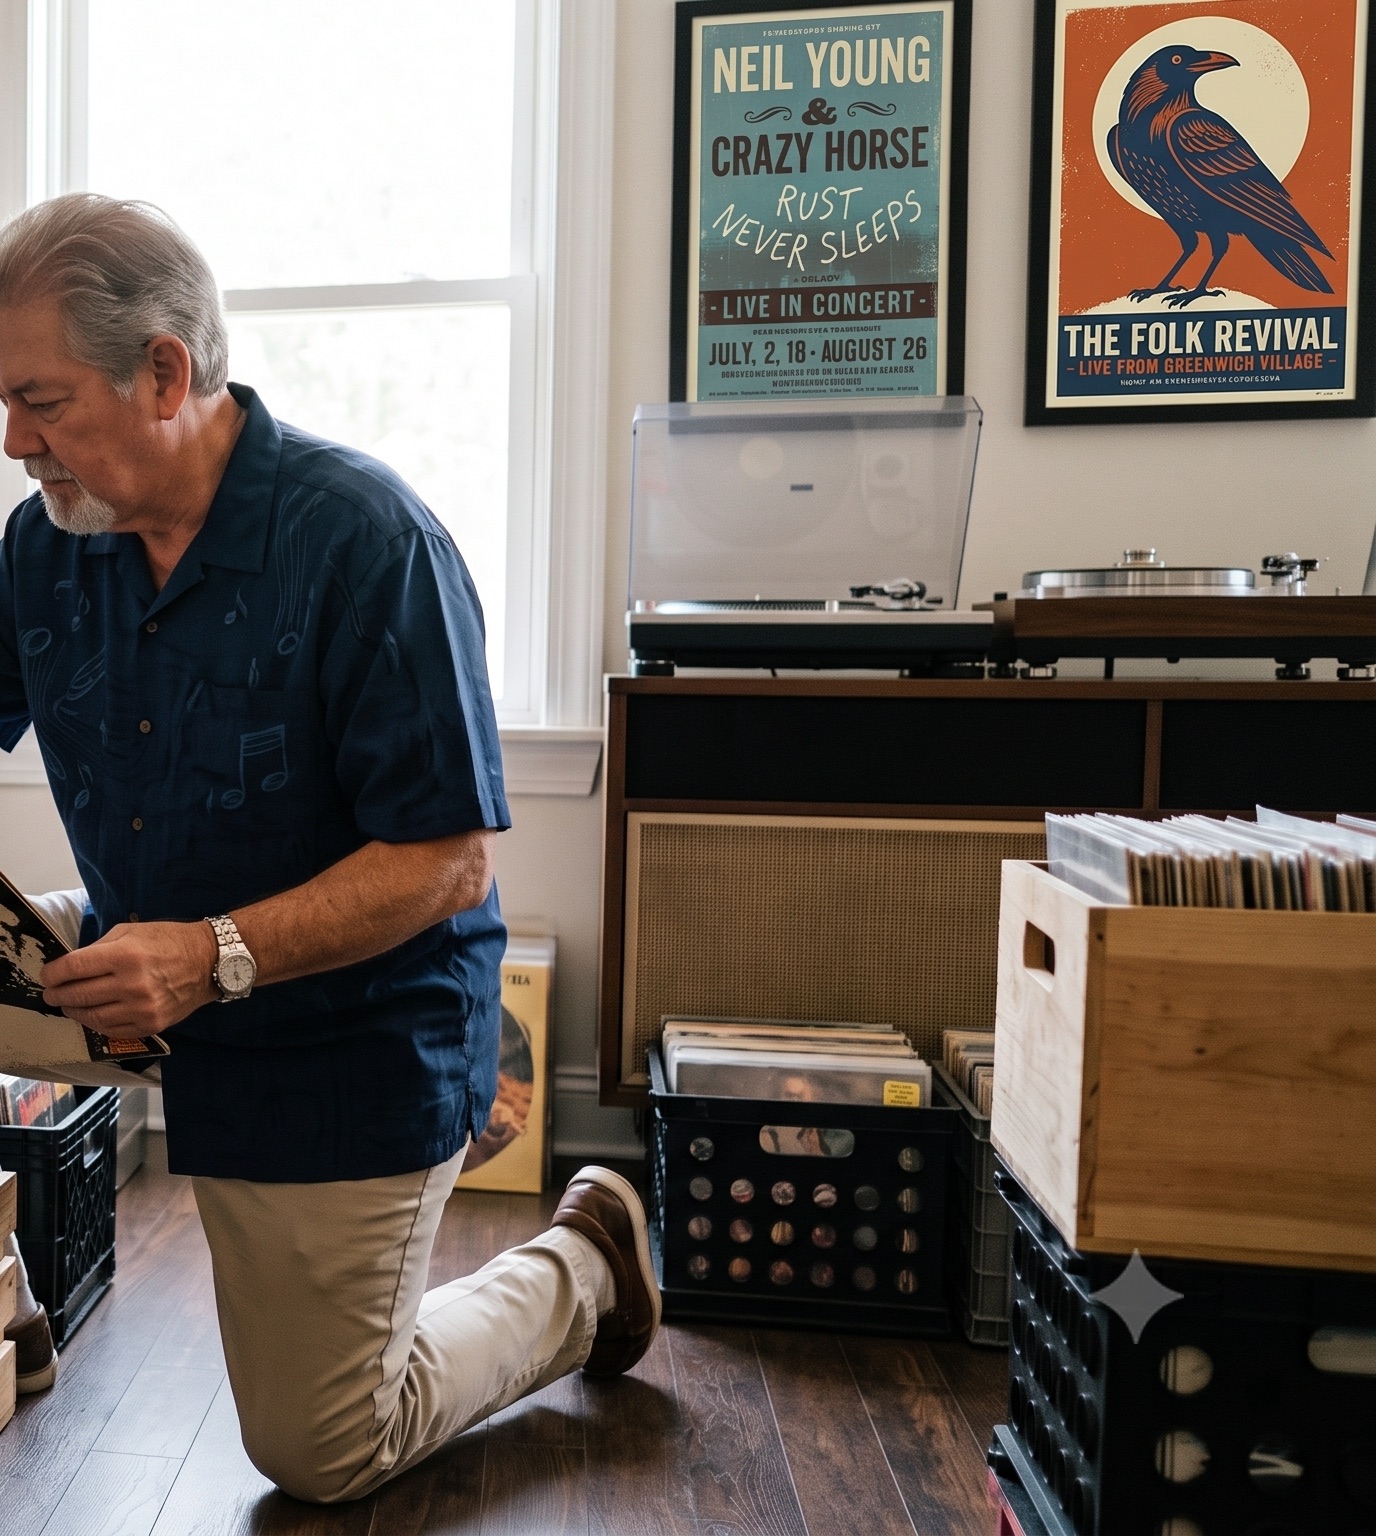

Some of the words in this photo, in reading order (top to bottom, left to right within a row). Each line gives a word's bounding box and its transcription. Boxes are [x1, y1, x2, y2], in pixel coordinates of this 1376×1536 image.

[713, 44, 794, 94] NEIL
[805, 35, 931, 89] YOUNG
[801, 97, 838, 126] &
[711, 132, 814, 177] CRAZY
[824, 126, 929, 173] HORSE
[776, 184, 863, 223] RUST
[712, 203, 808, 272] NEVER
[820, 189, 922, 265] SLEEPS
[723, 294, 770, 320] LIVE
[780, 293, 803, 317] IN
[812, 290, 916, 317] CONCERT
[708, 341, 757, 367] JULY,
[764, 340, 781, 367] 2,
[786, 339, 807, 364] 18
[821, 337, 897, 363] AUGUST
[902, 336, 928, 361] 26
[1064, 323, 1121, 357] THE
[1131, 320, 1205, 355] FOLK
[1214, 316, 1339, 353] REVIVAL
[1079, 359, 1112, 376] LIVE
[1117, 357, 1159, 375] FROM
[1164, 355, 1254, 374] GREENWICH
[1259, 353, 1323, 372] VILLAGE
